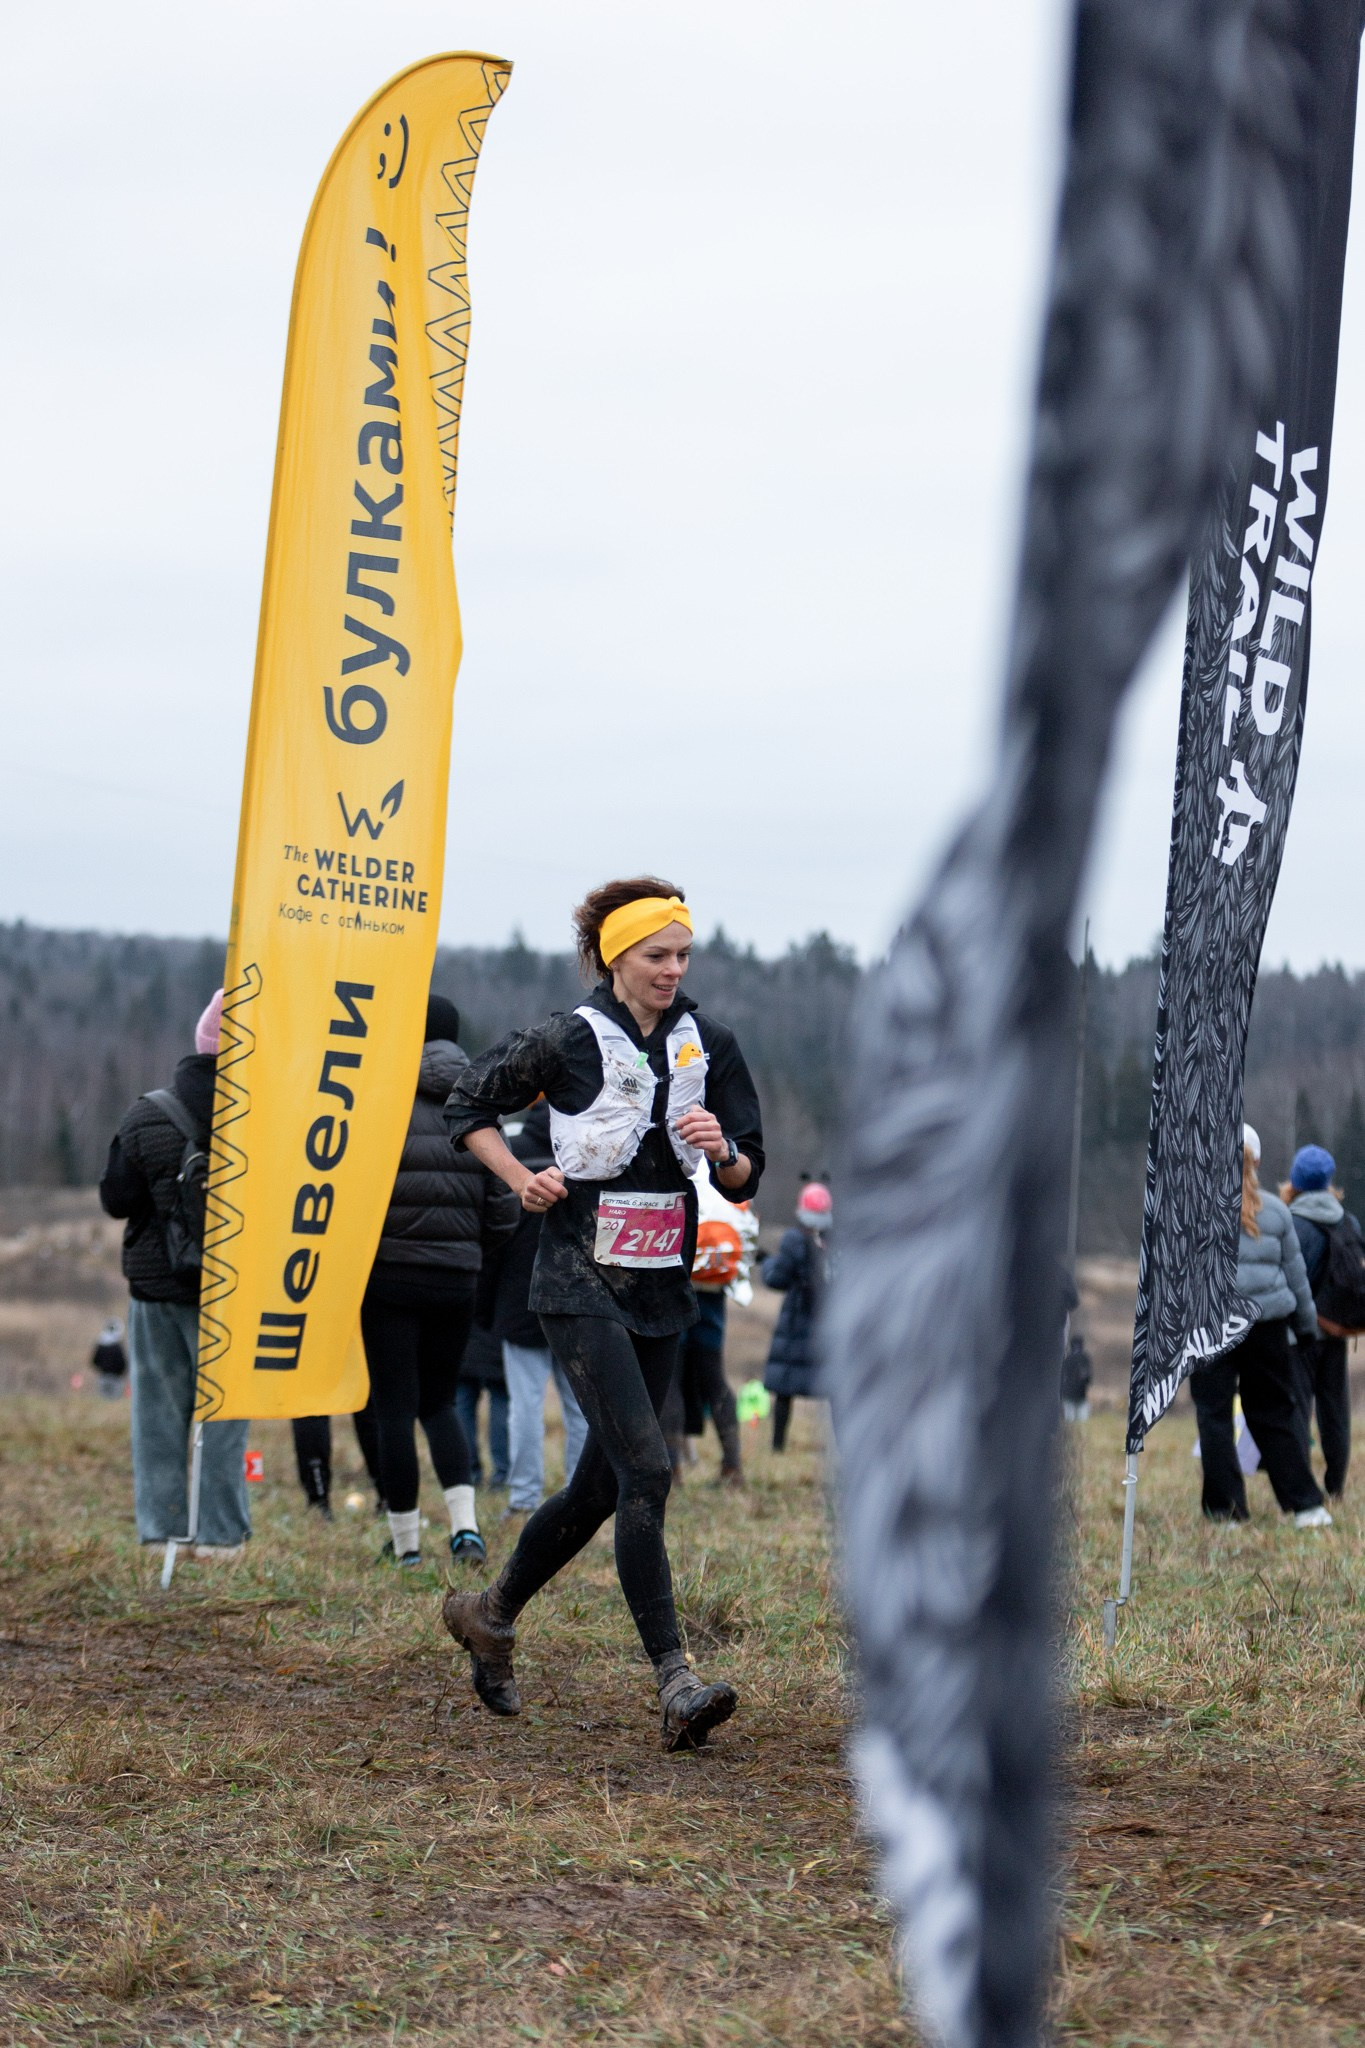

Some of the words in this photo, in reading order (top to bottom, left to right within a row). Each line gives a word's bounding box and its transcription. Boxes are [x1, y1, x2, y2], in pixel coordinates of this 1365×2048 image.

[1222, 420, 1284, 747] TRAIL
[1250, 446, 1318, 736] WILD
[284, 844, 308, 863] The
[315, 848, 415, 883] WELDER
[297, 873, 428, 913] CATHERINE
[278, 902, 313, 925] Кофе
[320, 911, 329, 925] с
[253, 980, 375, 1371] Шевели
[602, 1221, 619, 1231] 20
[620, 1228, 681, 1252] 2147
